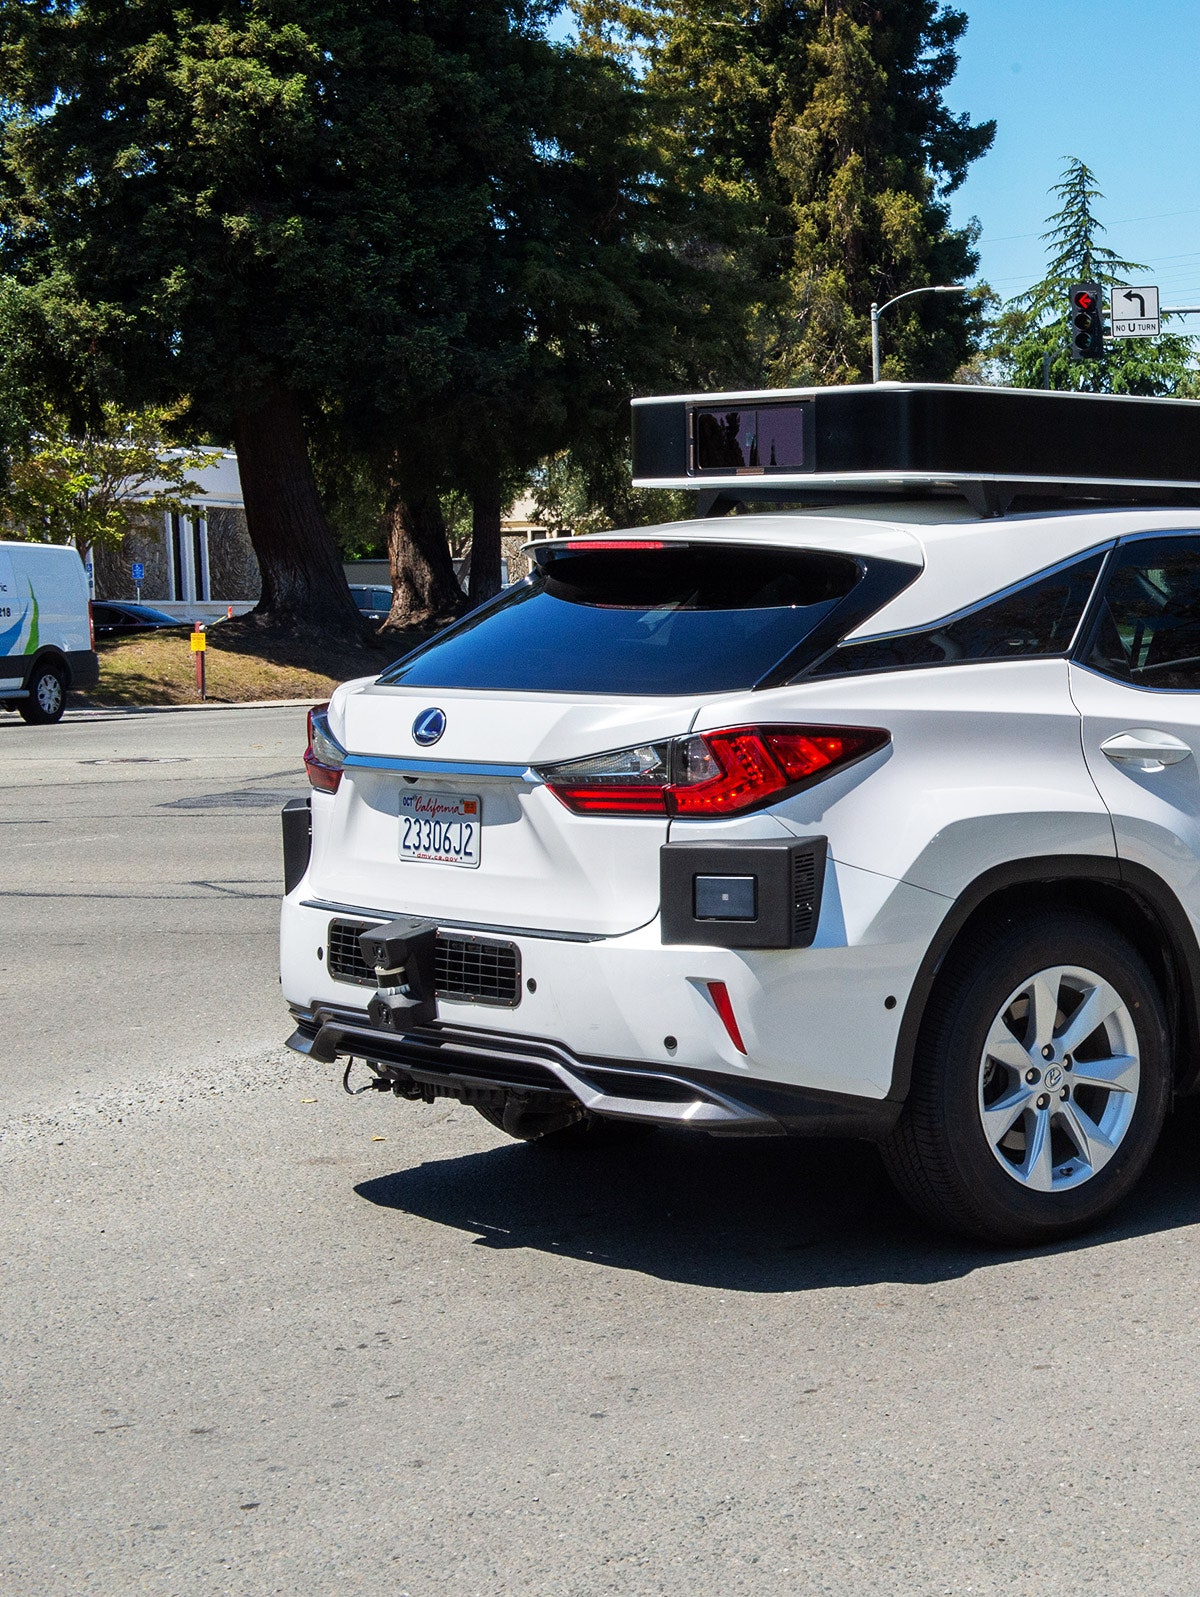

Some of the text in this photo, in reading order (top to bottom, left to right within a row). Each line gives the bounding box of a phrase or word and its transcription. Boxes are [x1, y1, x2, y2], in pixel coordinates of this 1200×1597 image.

[1116, 323, 1156, 332] NO U TURN
[403, 796, 412, 807] OCT
[415, 795, 464, 818] California
[402, 817, 473, 857] 23306J2
